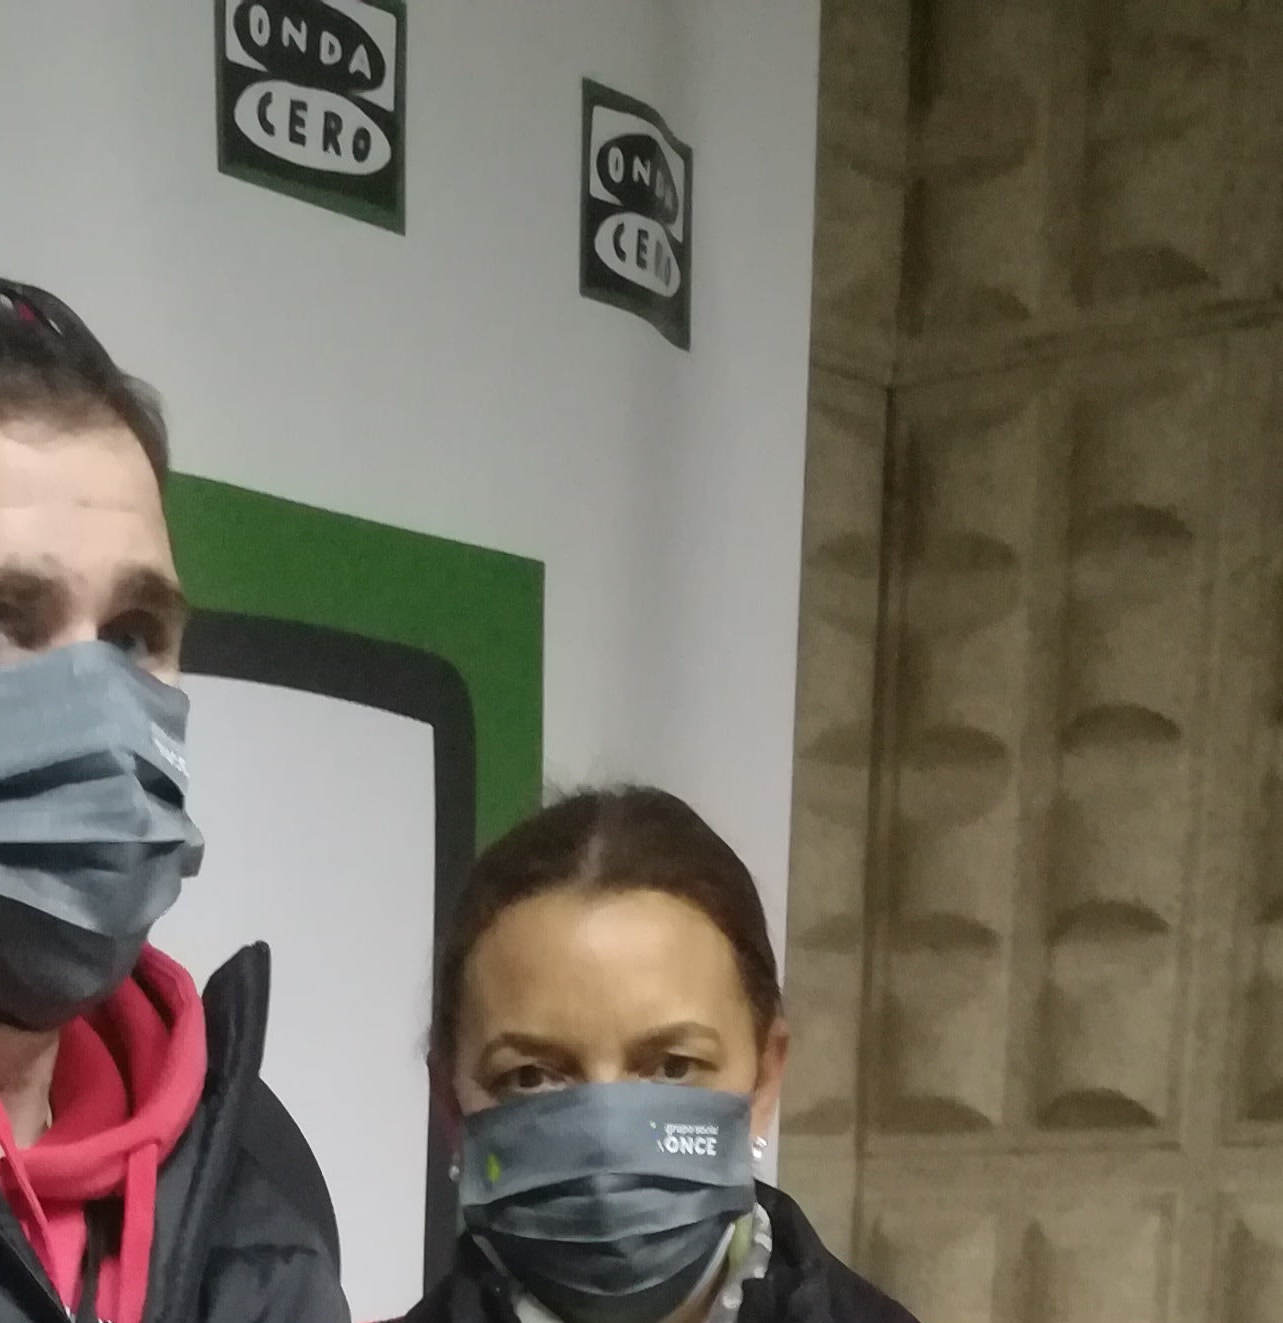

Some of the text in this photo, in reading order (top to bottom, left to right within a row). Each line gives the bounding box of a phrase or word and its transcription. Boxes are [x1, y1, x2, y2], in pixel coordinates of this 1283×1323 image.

[248, 4, 372, 81] ONDA
[256, 91, 372, 163] CERO
[664, 1135, 718, 1156] ONCE
